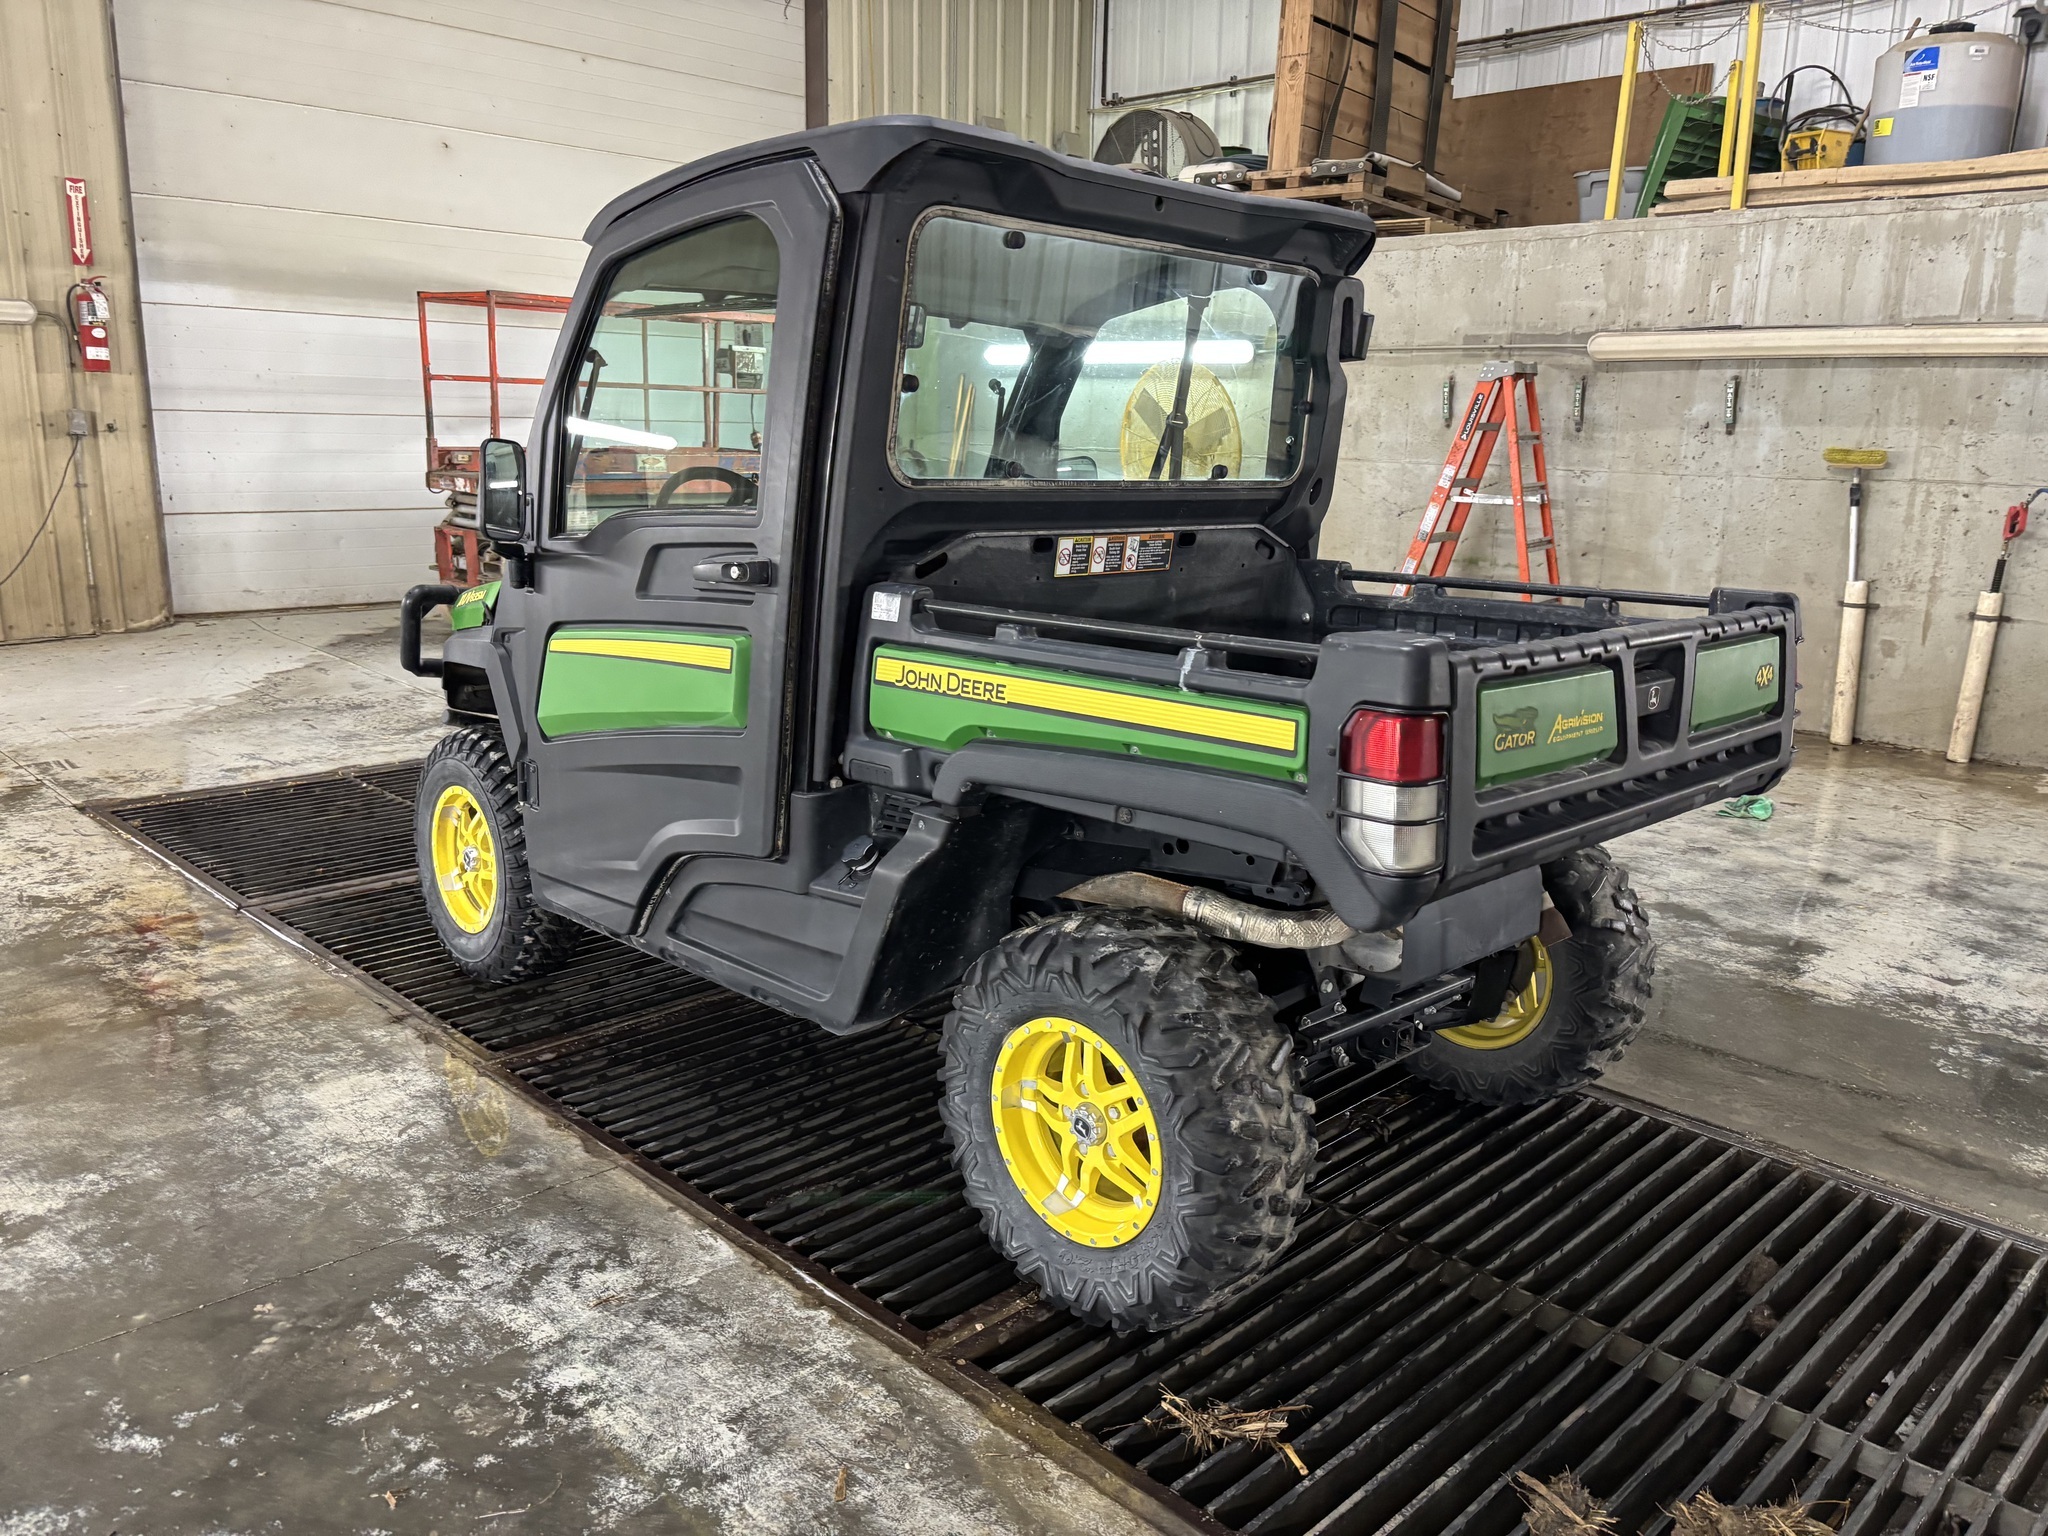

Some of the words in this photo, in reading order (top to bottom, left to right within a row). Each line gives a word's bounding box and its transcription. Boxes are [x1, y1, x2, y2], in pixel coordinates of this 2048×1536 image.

[1922, 73, 1935, 81] NSF
[69, 185, 83, 194] FIRE
[74, 195, 85, 259] EXTINGUISHER
[1465, 393, 1484, 435] LOUISVILLE
[895, 665, 942, 690] JOHN
[946, 672, 1007, 700] DEERE
[1756, 665, 1773, 687] 4X4
[1547, 709, 1604, 745] AGRIVISION
[1552, 730, 1584, 743] EQUIPMENT
[1585, 726, 1604, 736] GROUP
[1494, 730, 1536, 752] GATOR
